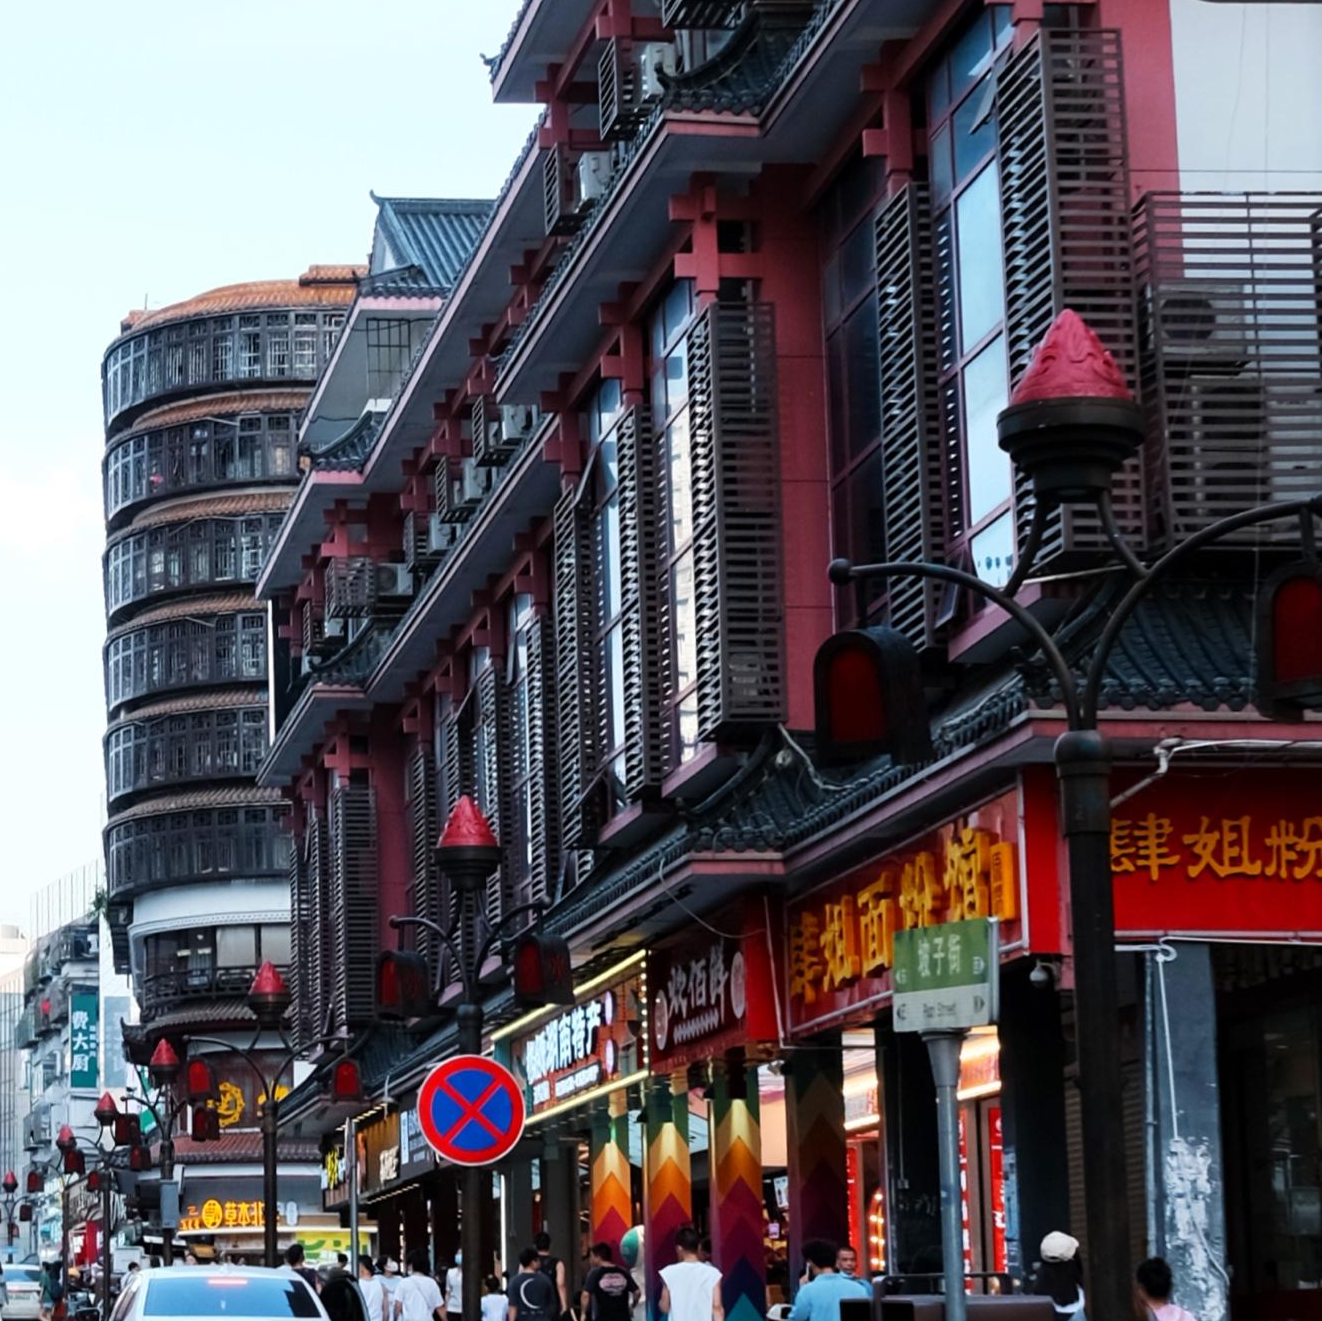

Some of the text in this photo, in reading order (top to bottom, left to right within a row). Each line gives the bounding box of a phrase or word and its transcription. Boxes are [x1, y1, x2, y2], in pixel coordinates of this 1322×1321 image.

[918, 933, 962, 978] 坡子街
[72, 1010, 89, 1072] 费大厨
